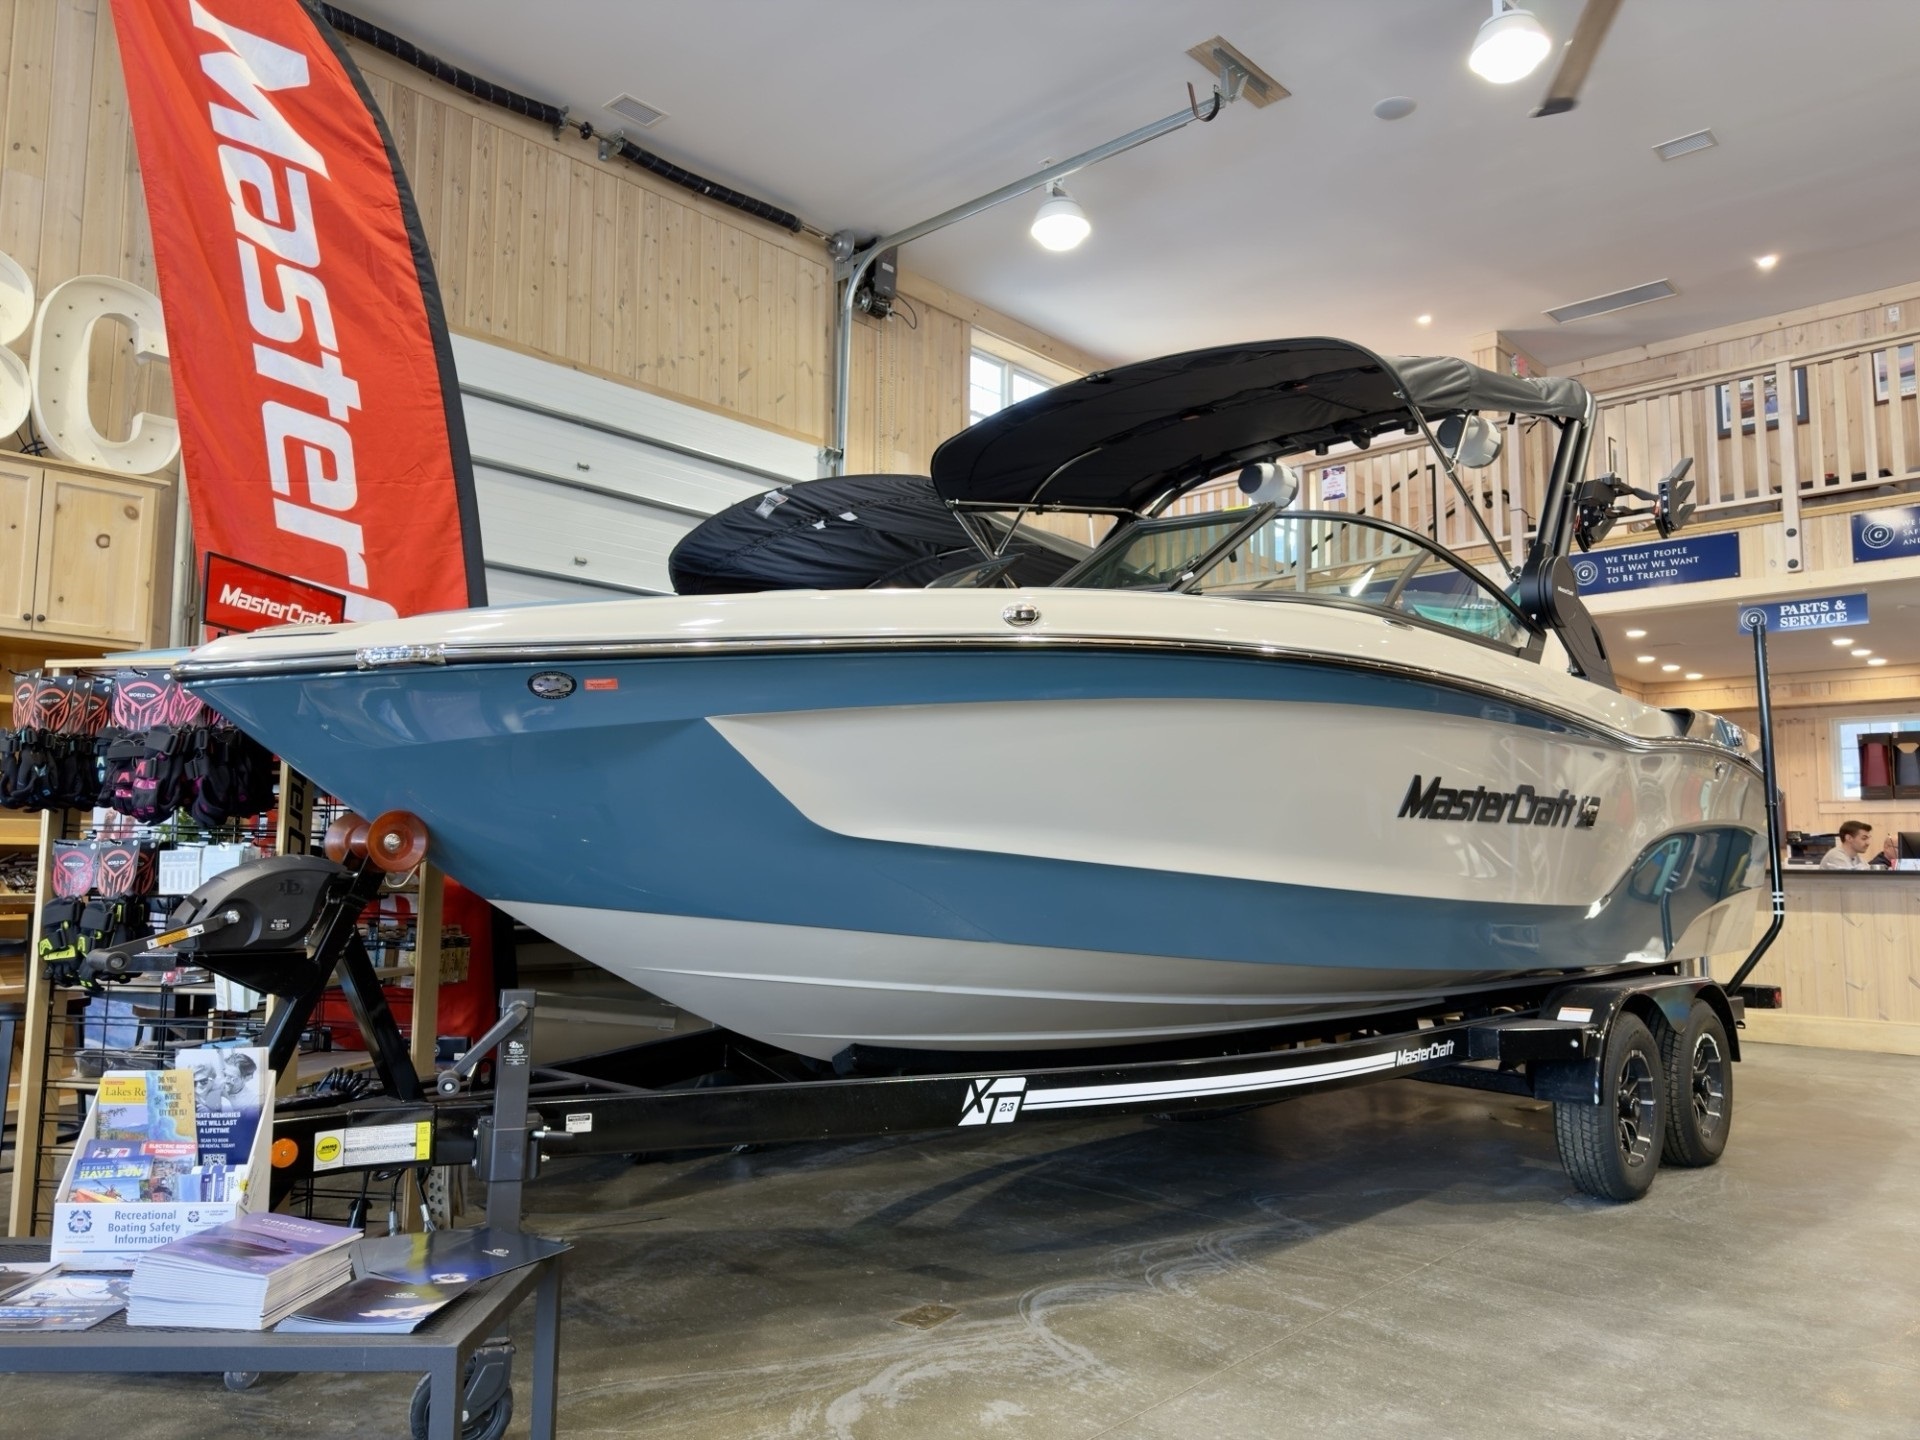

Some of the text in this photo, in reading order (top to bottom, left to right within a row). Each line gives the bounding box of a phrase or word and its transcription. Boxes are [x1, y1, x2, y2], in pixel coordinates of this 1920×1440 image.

[1604, 547, 1688, 564] WE TREAT PEOPLE
[1606, 556, 1699, 574] THE WAY WE WANT
[1623, 574, 1633, 582] BE
[1636, 568, 1678, 580] TREATED
[219, 583, 333, 625] MasterCraft
[1779, 600, 1847, 616] PARTS &
[1779, 611, 1848, 628] SERVICE
[1397, 774, 1578, 828] MasterCraft
[1396, 1039, 1454, 1067] MasterCraft
[105, 1086, 132, 1097] Lakes
[999, 1102, 1016, 1113] 23
[80, 1168, 144, 1178] HAVE FUN
[114, 1210, 176, 1220] Recreational
[108, 1222, 181, 1234] Boating Safety
[114, 1234, 174, 1244] Information
